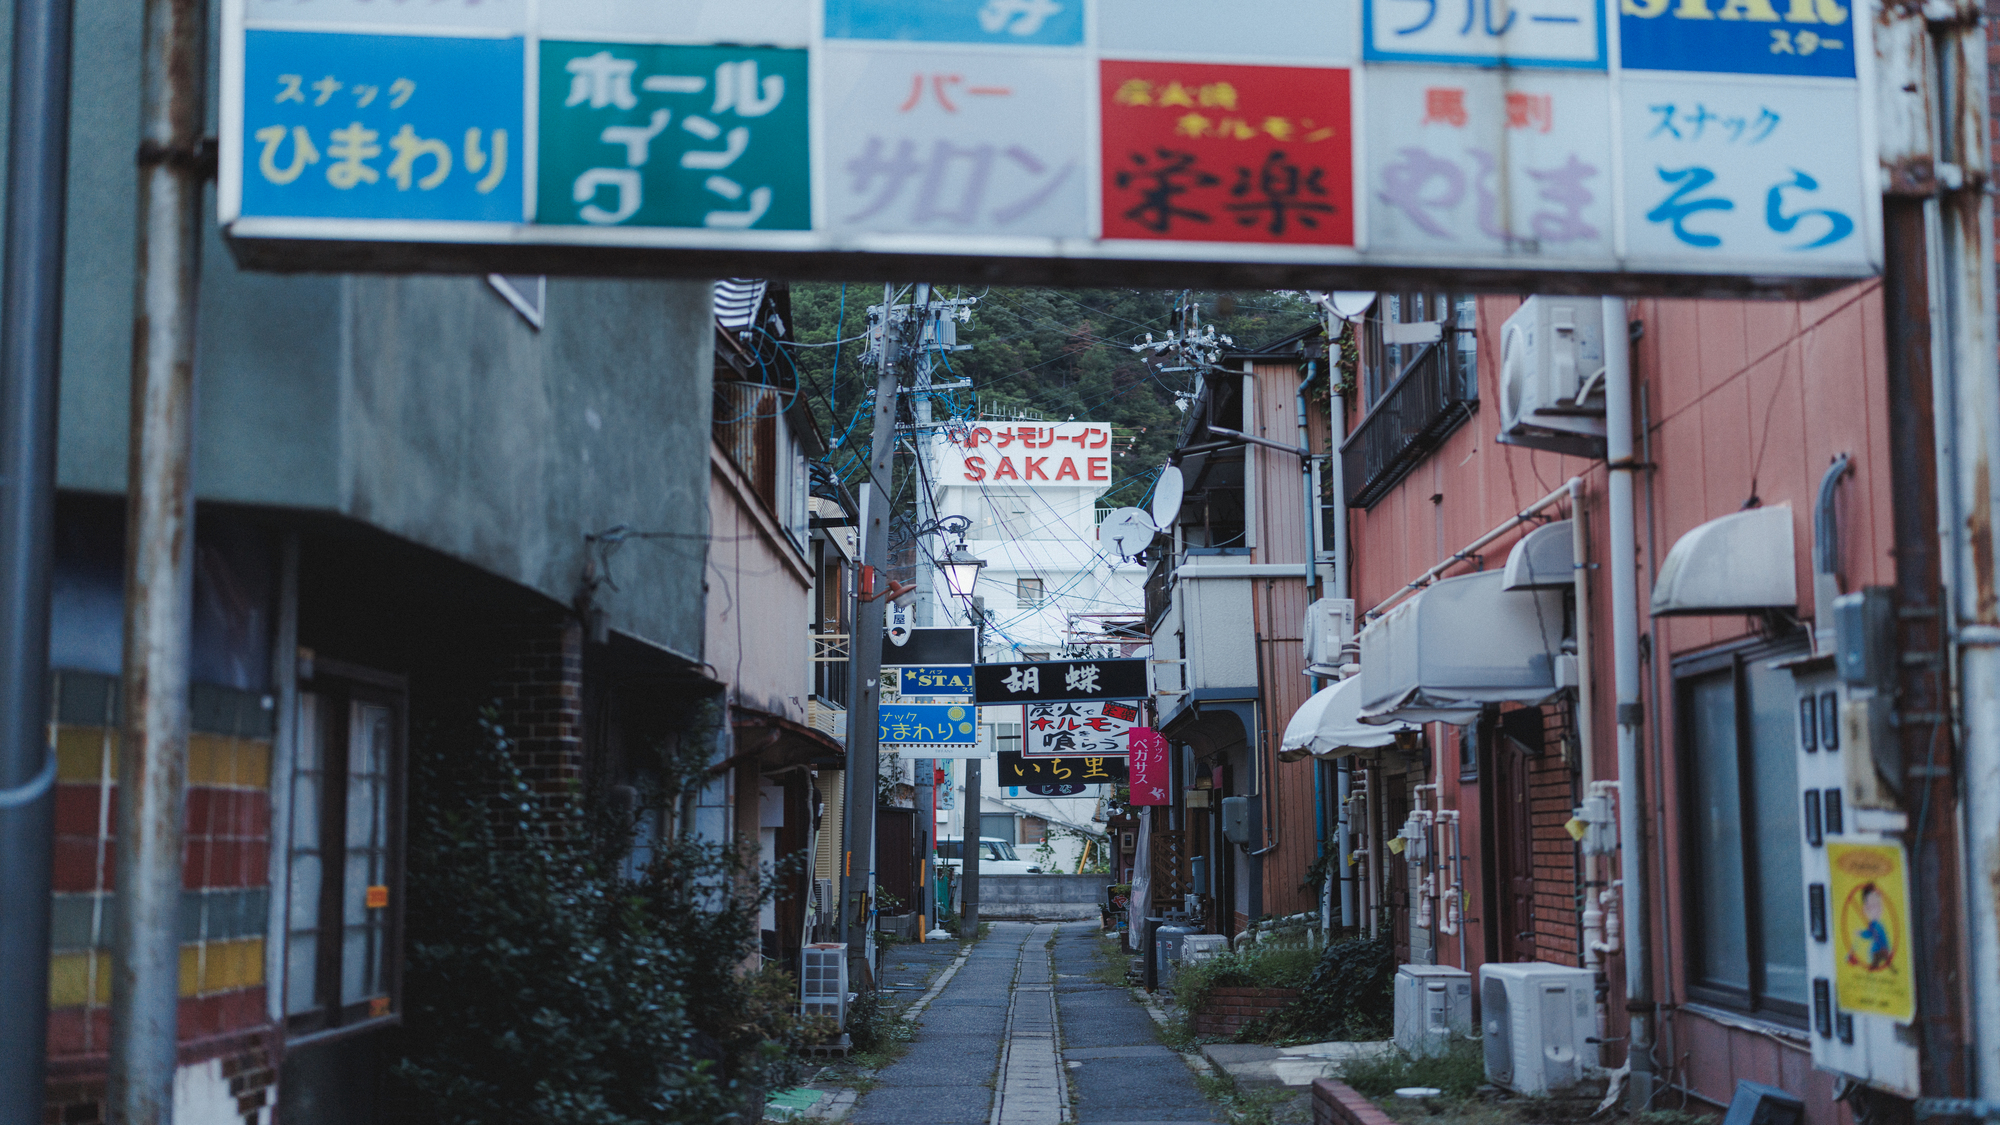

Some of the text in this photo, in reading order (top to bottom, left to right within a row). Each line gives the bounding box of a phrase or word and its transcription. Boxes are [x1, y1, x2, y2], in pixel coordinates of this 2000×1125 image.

[1768, 28, 1845, 57] スター
[276, 73, 416, 109] スナック
[565, 51, 784, 116] ホール
[900, 73, 1012, 113] バー
[1420, 85, 1554, 135] 馬刺
[1645, 102, 1782, 145] スナック
[254, 121, 508, 194] ひまわり
[601, 108, 749, 169] イン
[573, 167, 772, 228] ワン
[844, 136, 1079, 225] サロン
[1375, 144, 1600, 243] やしま
[1645, 165, 1854, 251] そら
[997, 427, 1108, 449] メモリーイン
[963, 456, 1109, 481] SAKAE
[1001, 664, 1101, 694] 胡蝶
[879, 712, 917, 722] ナック
[1133, 739, 1149, 785] ペガサス
[1153, 731, 1163, 763] スナック
[1014, 758, 1109, 780] いち里
